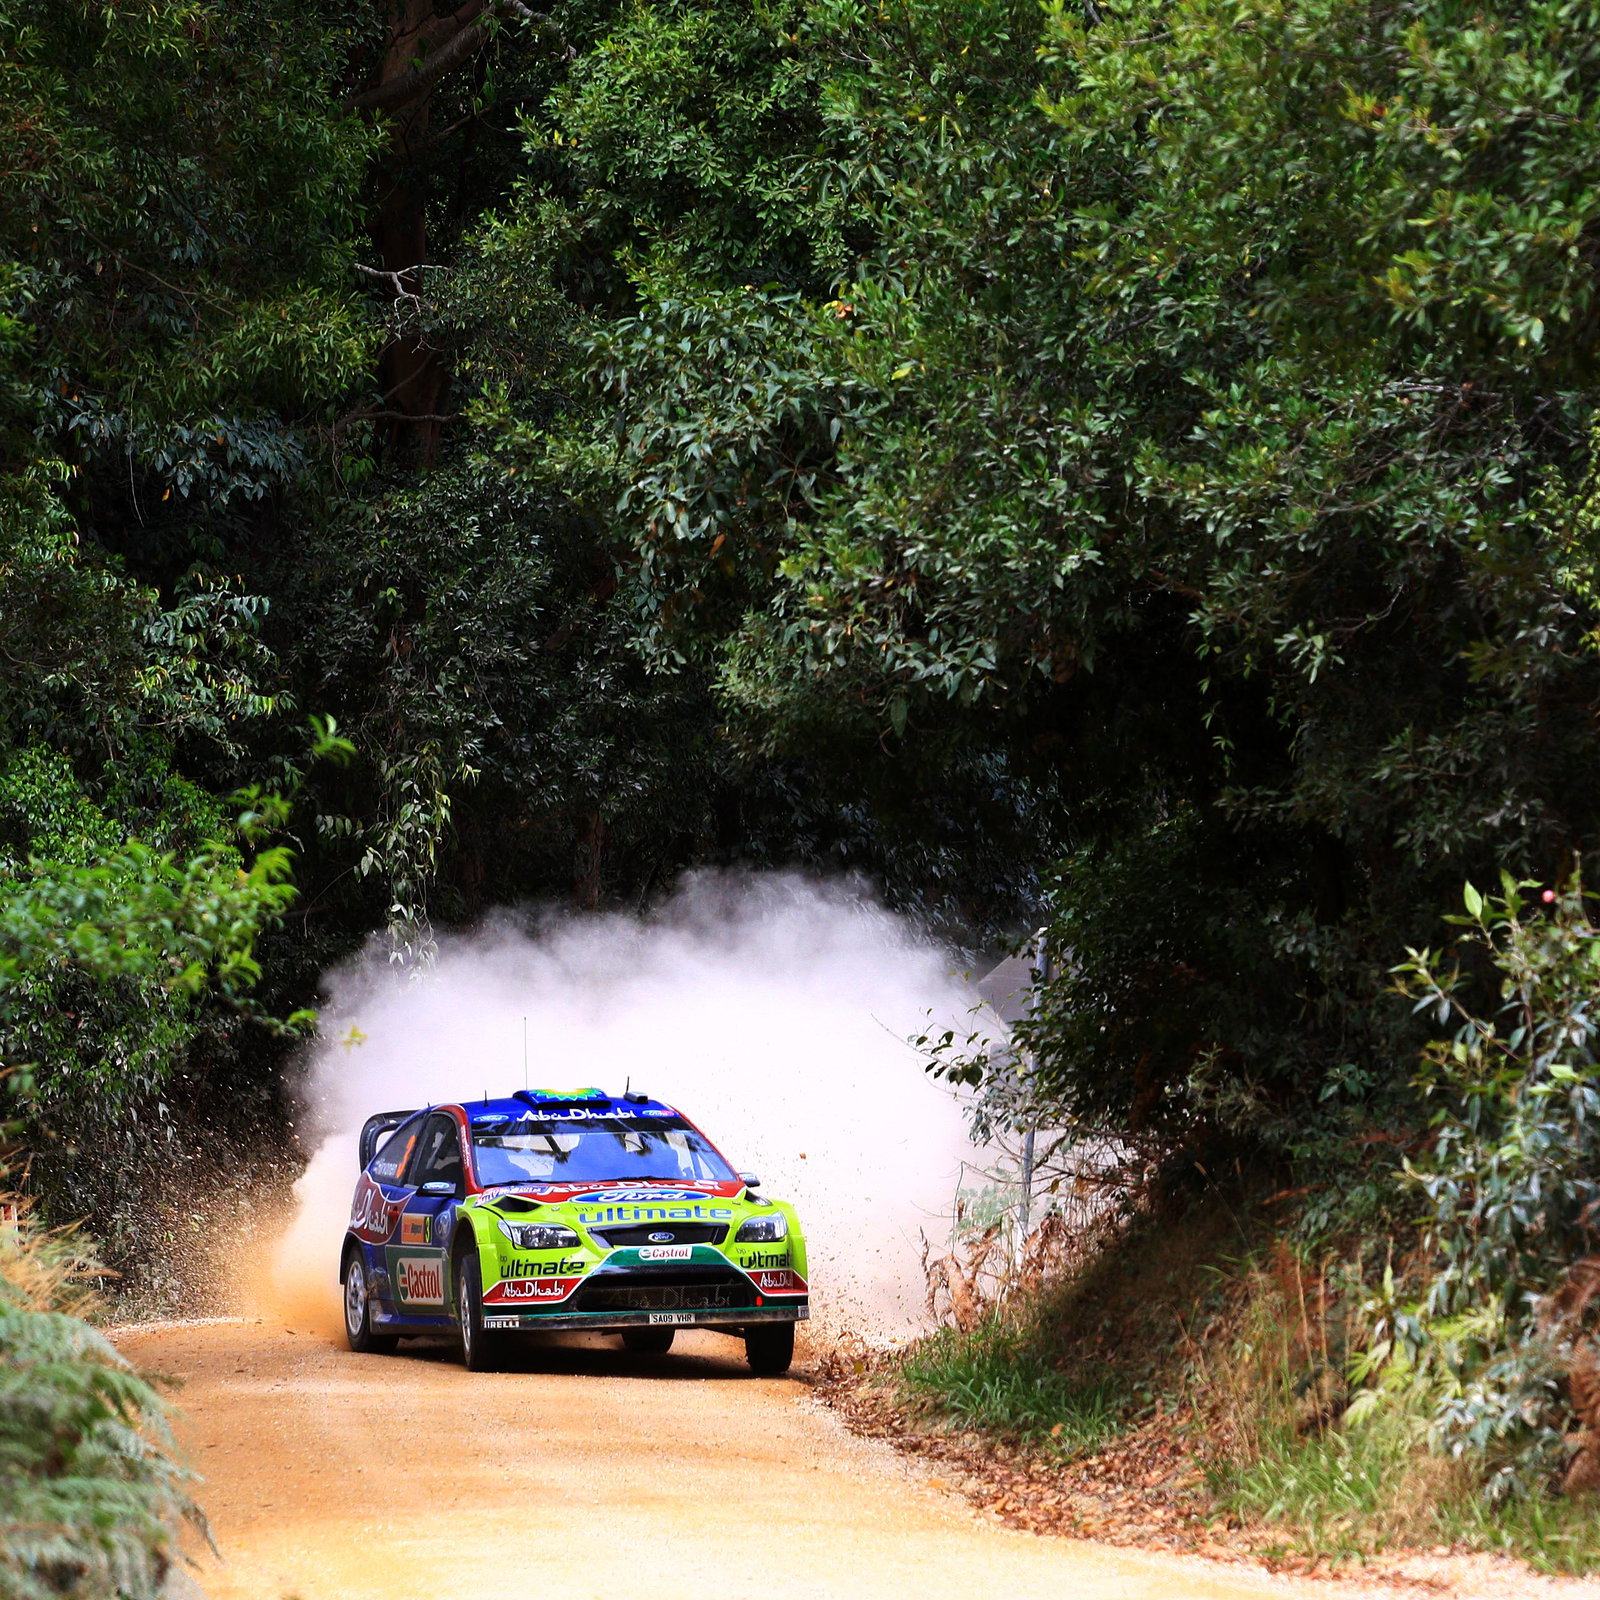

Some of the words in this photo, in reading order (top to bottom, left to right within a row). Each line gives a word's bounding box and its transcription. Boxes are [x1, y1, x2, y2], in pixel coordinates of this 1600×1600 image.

[598, 1190, 687, 1201] Ford
[579, 1205, 732, 1225] ultimate
[424, 1216, 431, 1243] 3
[652, 1247, 689, 1258] Castrol
[740, 1249, 790, 1268] ultimat
[500, 1258, 585, 1278] ultimate
[407, 1263, 442, 1299] Castrol
[653, 1314, 673, 1323] SA09
[676, 1314, 692, 1323] VHR
